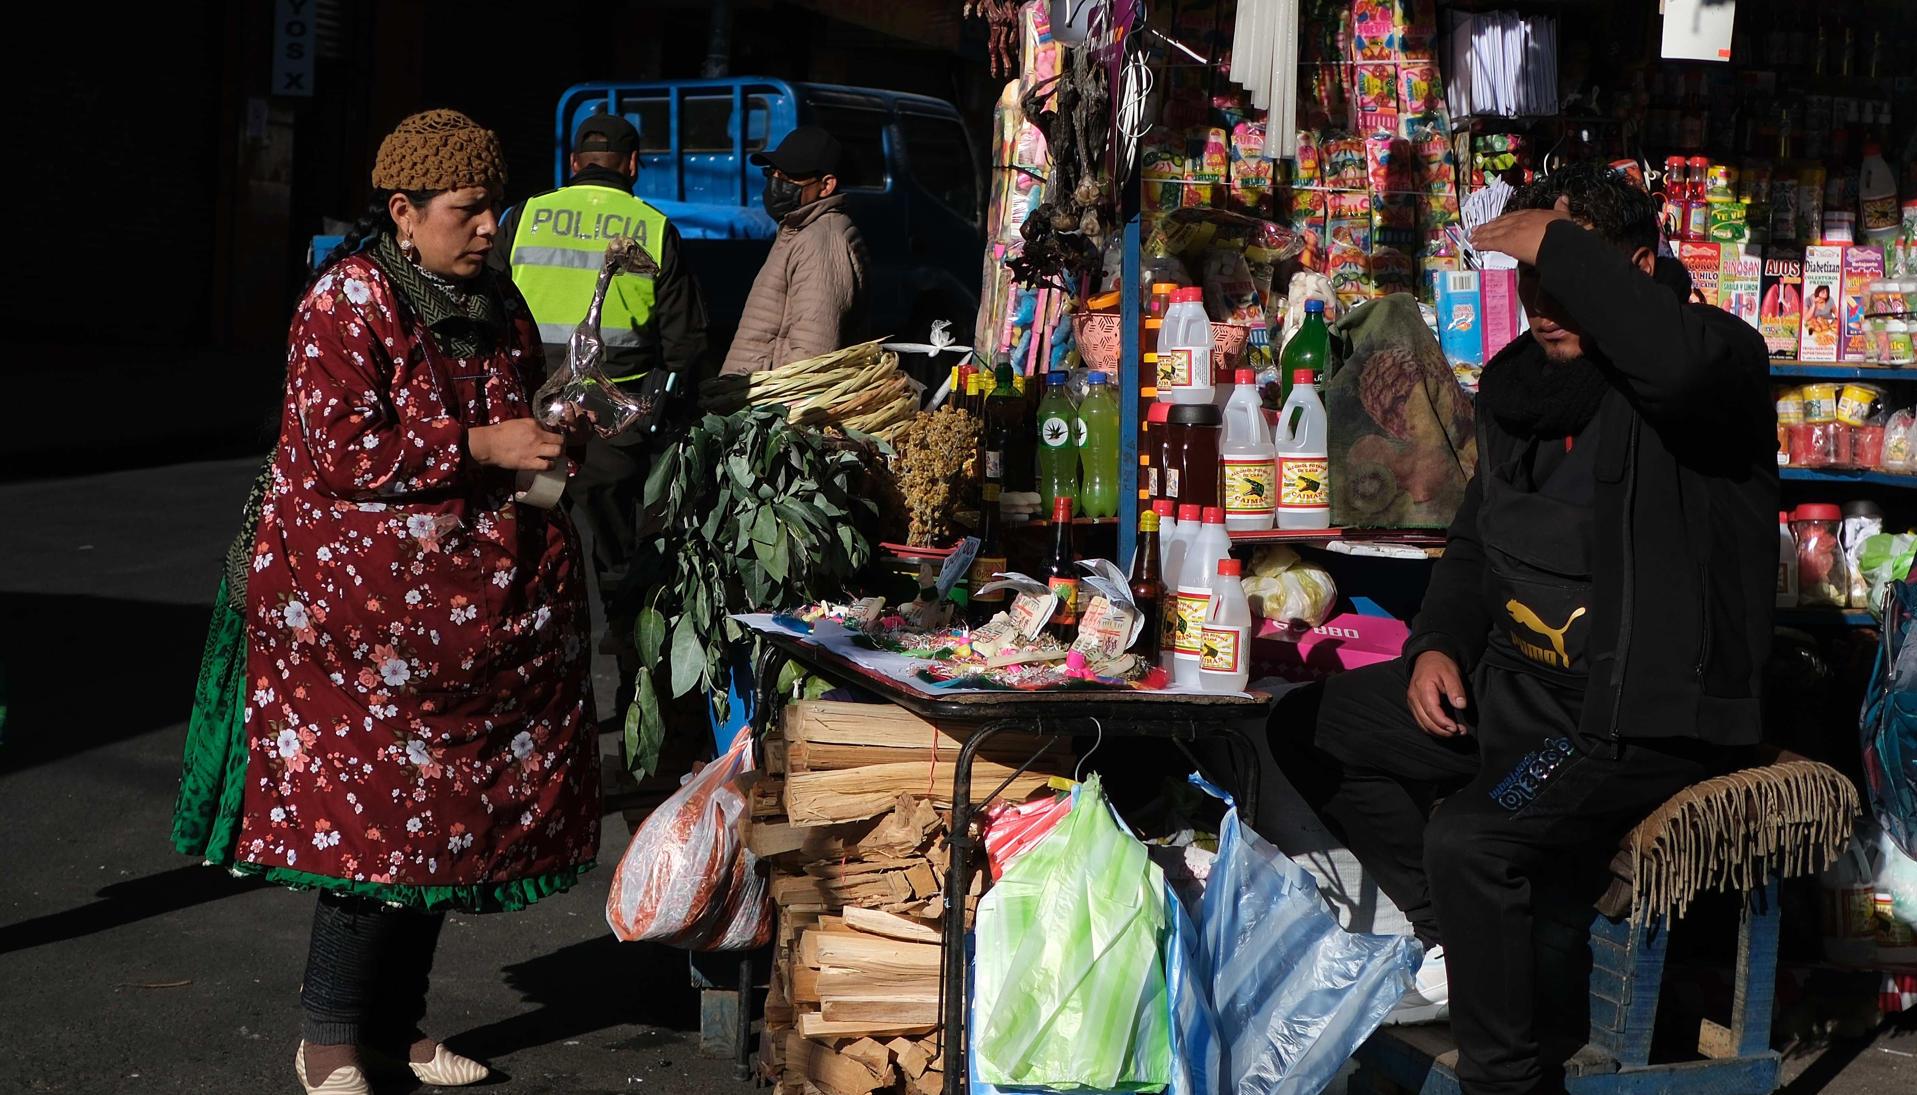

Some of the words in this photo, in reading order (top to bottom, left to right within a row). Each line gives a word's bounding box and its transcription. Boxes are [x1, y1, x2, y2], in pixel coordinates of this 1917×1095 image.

[531, 208, 648, 247] POLICIA
[1764, 259, 1800, 277] AJOS
[1234, 494, 1269, 505] CAIMAN
